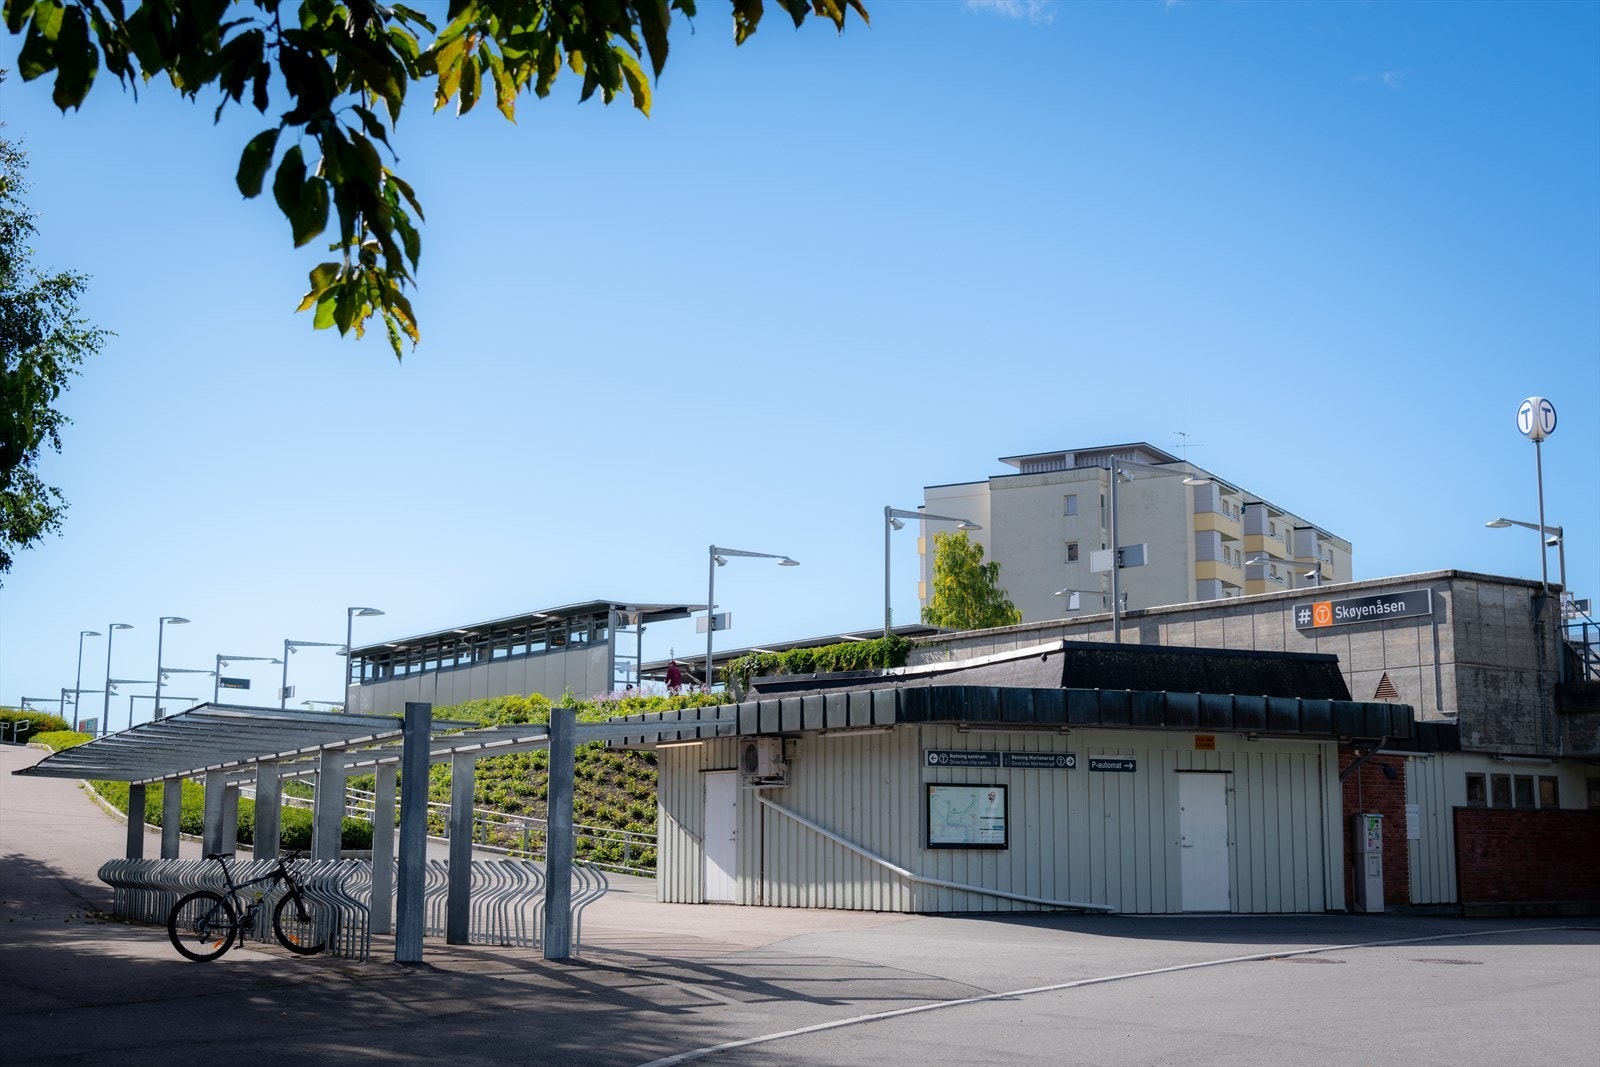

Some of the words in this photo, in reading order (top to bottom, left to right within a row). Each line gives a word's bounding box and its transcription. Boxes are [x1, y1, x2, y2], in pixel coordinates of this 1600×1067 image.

[1521, 408, 1530, 429] T
[1541, 407, 1551, 428] T
[1335, 599, 1406, 620] Skøyenåsen
[1091, 761, 1122, 769] P-automat
